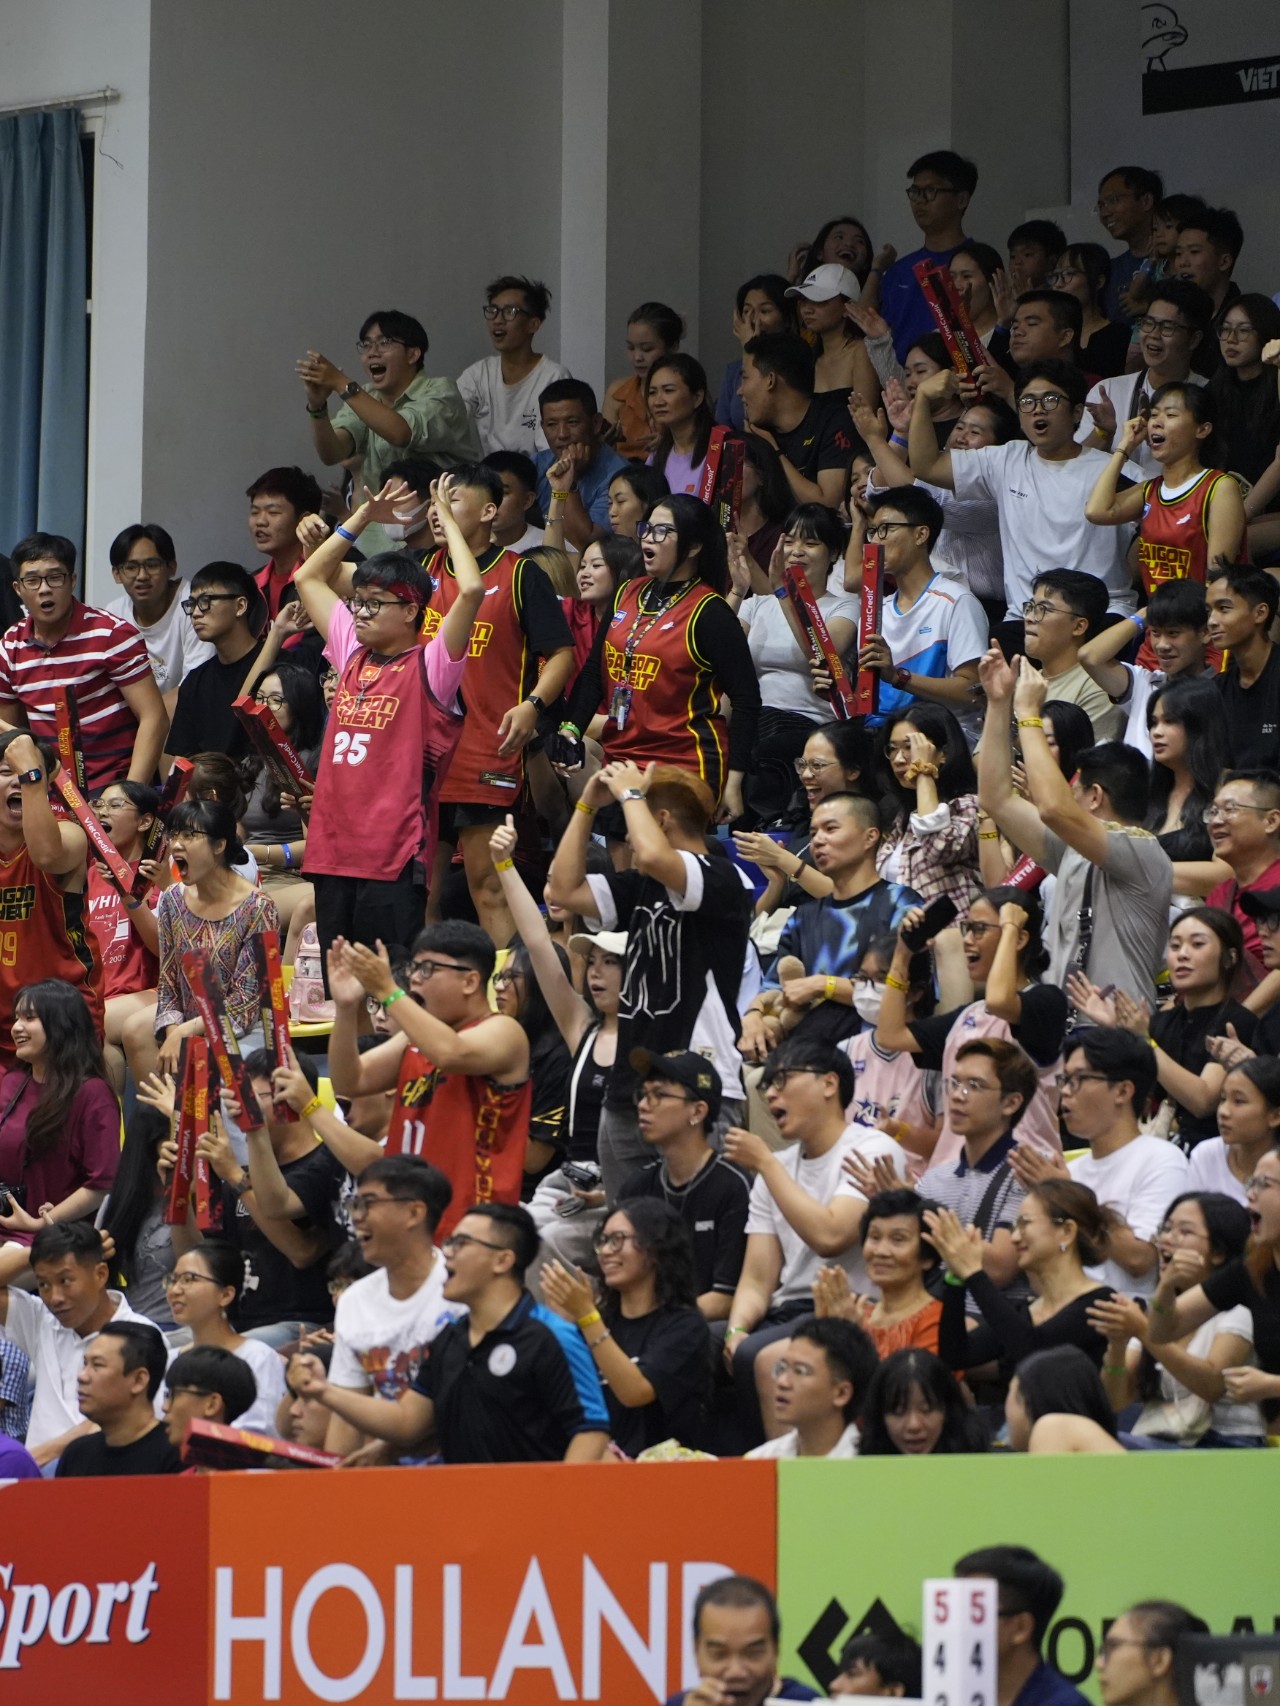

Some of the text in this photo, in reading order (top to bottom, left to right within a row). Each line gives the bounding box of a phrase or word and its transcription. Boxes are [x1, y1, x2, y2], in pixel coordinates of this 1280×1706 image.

[928, 298, 953, 340] VietCredit
[805, 599, 829, 642] VietCredit
[864, 585, 873, 630] VietCredit
[607, 652, 661, 675] SAGON
[341, 709, 393, 730] HEAT
[277, 739, 305, 777] VietCredit
[333, 731, 371, 767] 25
[82, 816, 115, 857] VietCredit
[196, 993, 219, 1042] VietCredit
[179, 1129, 190, 1179] VietCredit
[401, 1118, 426, 1156] 11
[934, 1591, 986, 1624] 5 5
[934, 1641, 984, 1675] 4 4
